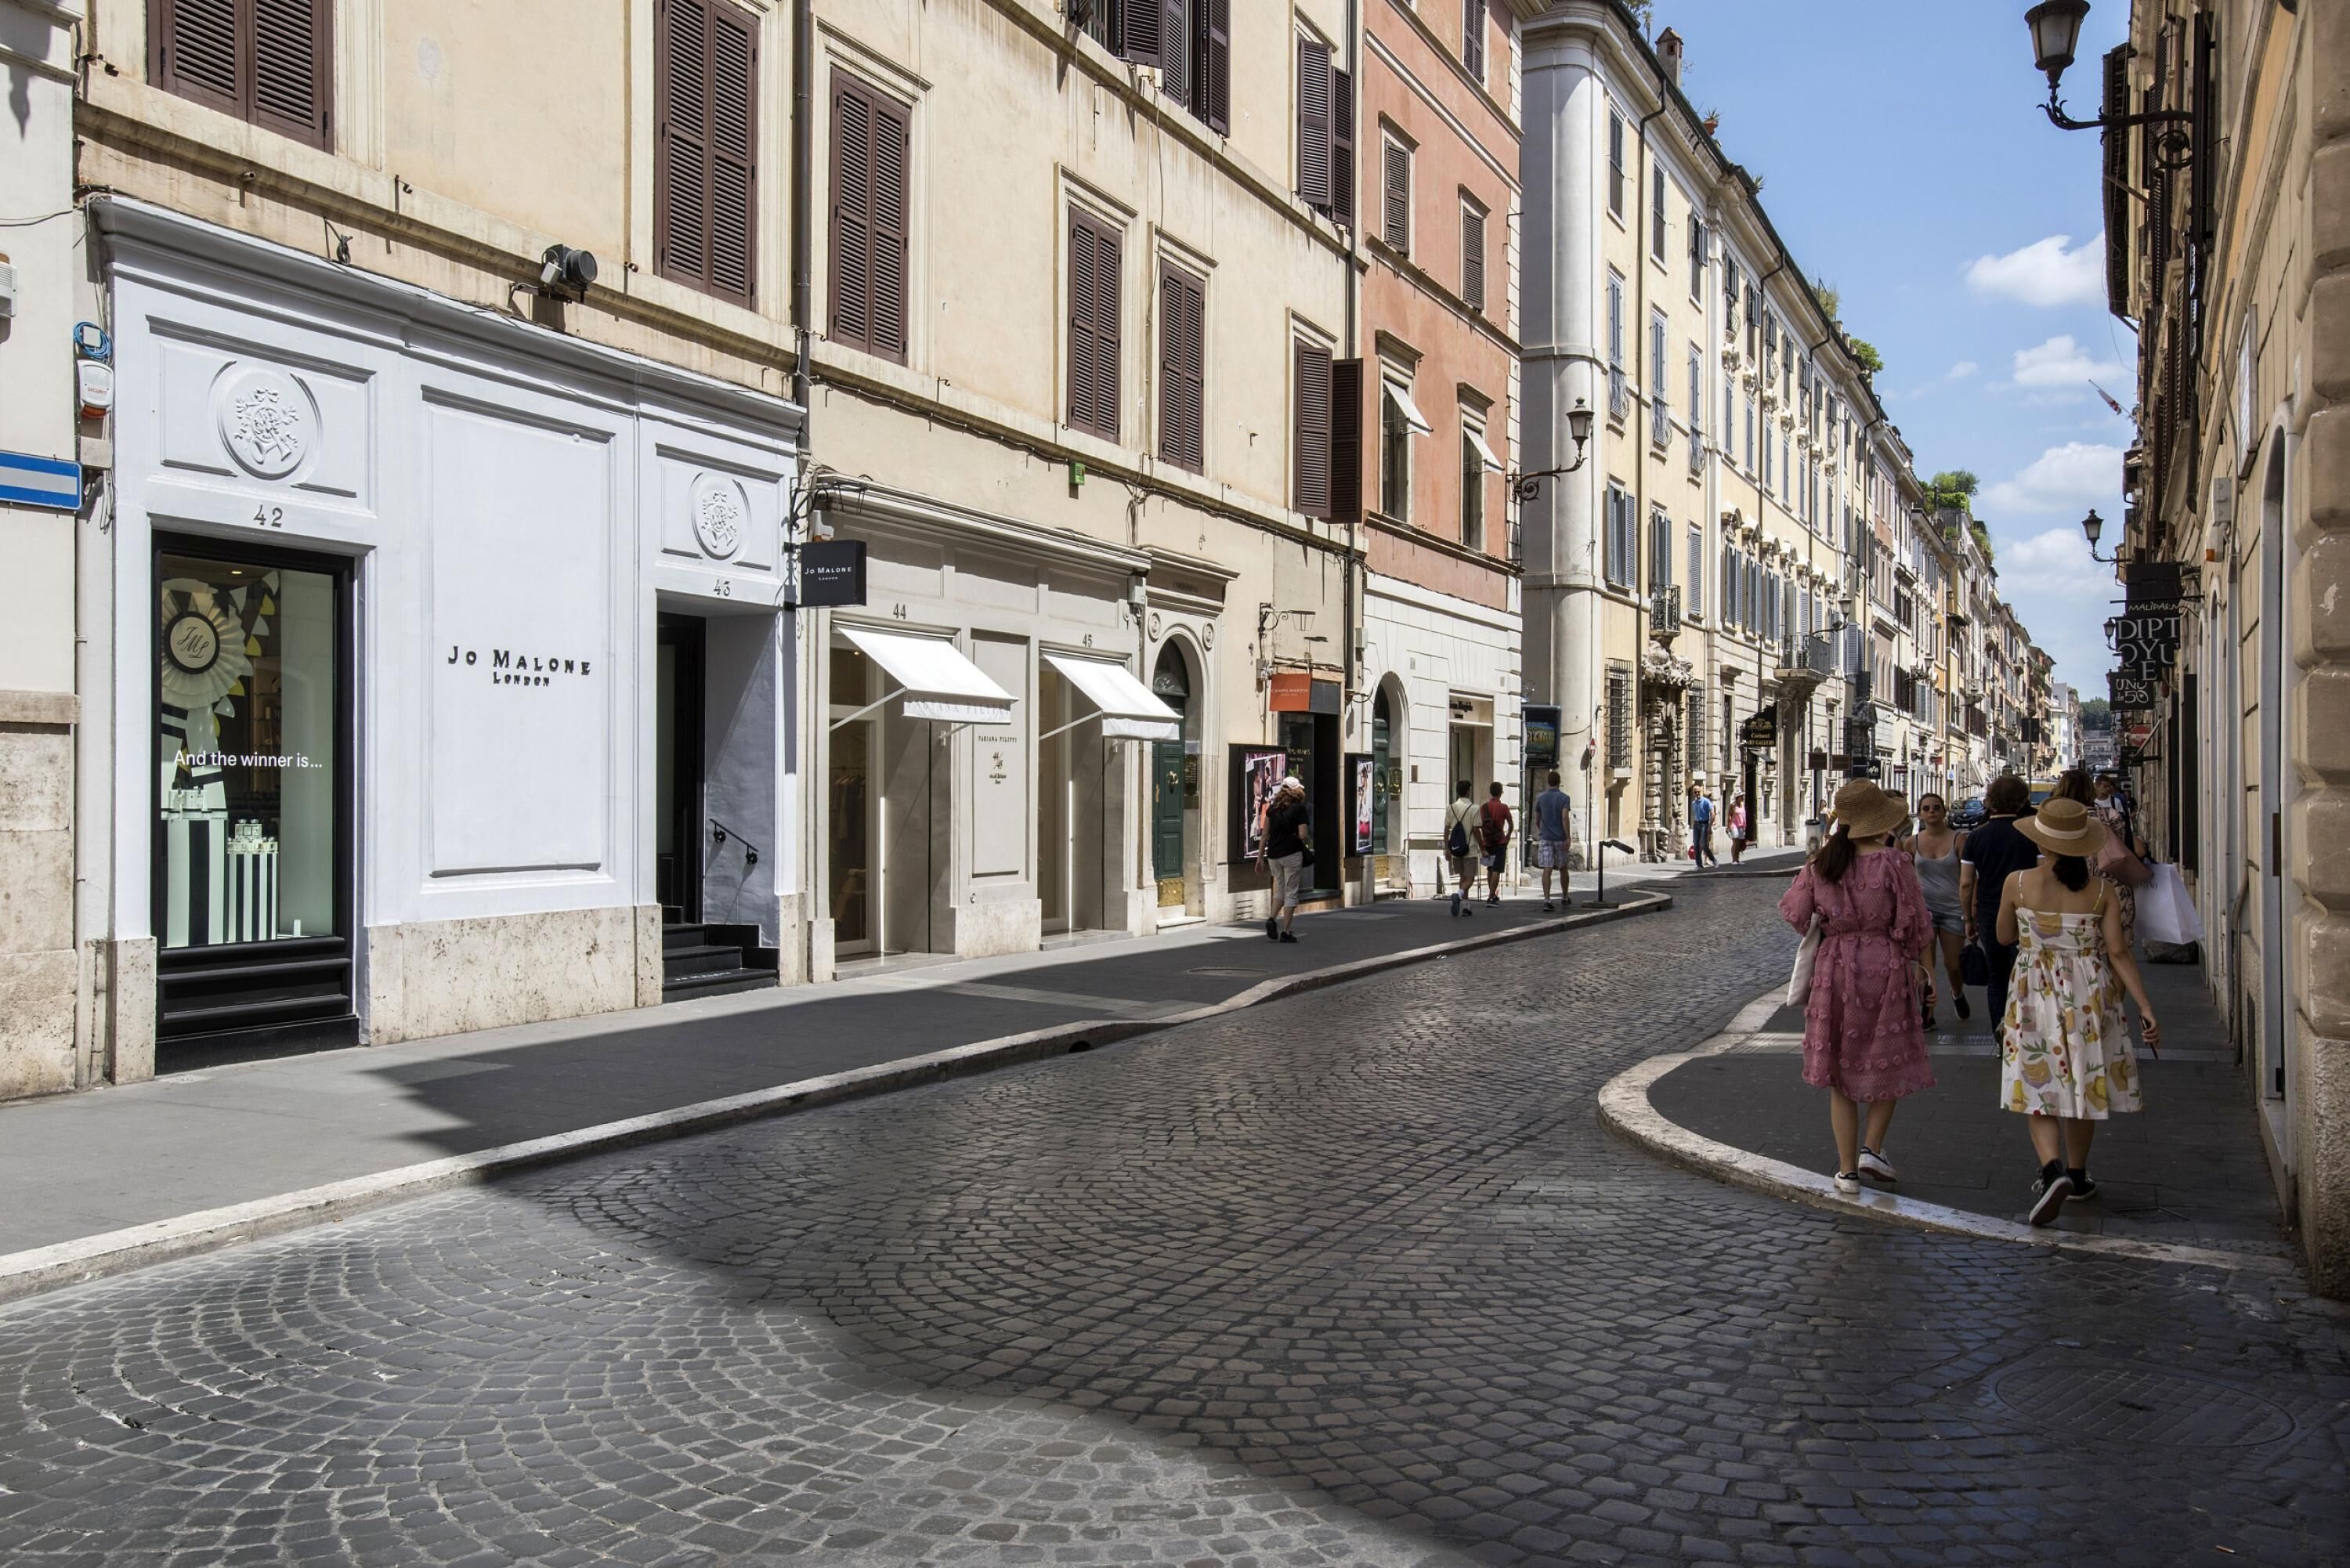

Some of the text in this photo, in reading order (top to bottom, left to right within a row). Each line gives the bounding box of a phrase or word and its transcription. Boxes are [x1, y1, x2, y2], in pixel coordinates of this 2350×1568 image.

[253, 504, 283, 528] 42
[713, 579, 731, 597] 43
[892, 602, 906, 620] 44
[2117, 617, 2180, 640] DIPT
[1083, 633, 1093, 649] 45
[173, 750, 206, 767] And
[210, 750, 237, 767] the
[240, 751, 294, 768] winner
